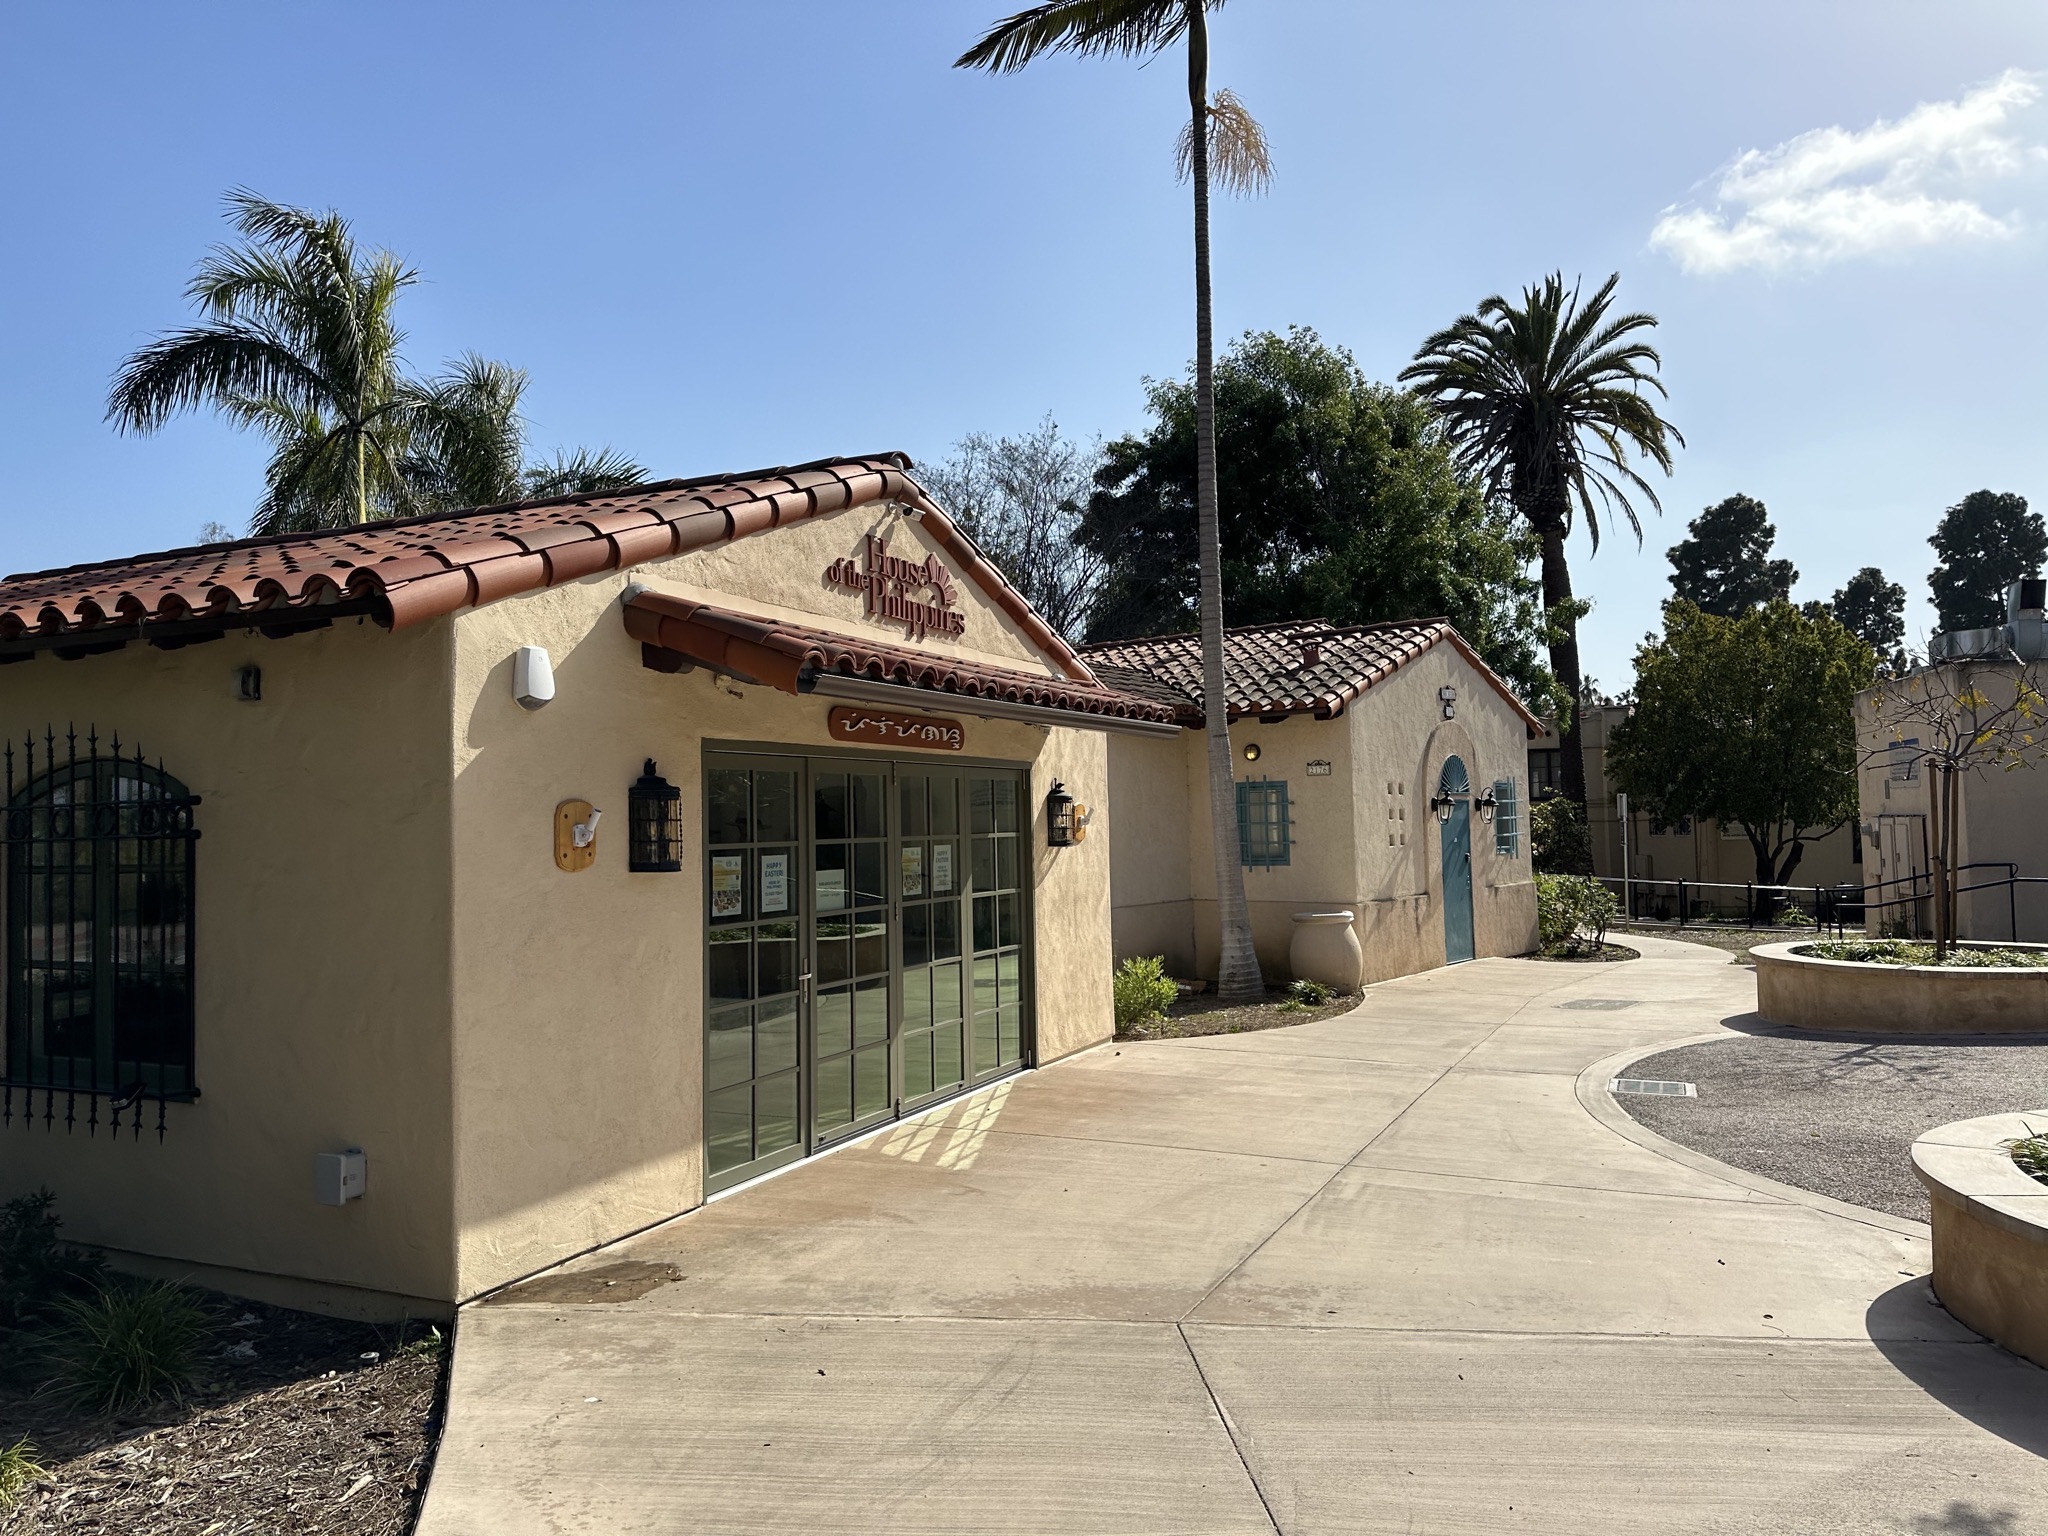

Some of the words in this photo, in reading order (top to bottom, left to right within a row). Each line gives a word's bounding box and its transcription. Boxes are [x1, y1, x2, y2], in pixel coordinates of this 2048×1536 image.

[826, 557, 845, 585] of
[844, 559, 870, 591] the
[865, 534, 930, 588] House
[868, 574, 966, 637] Philippines
